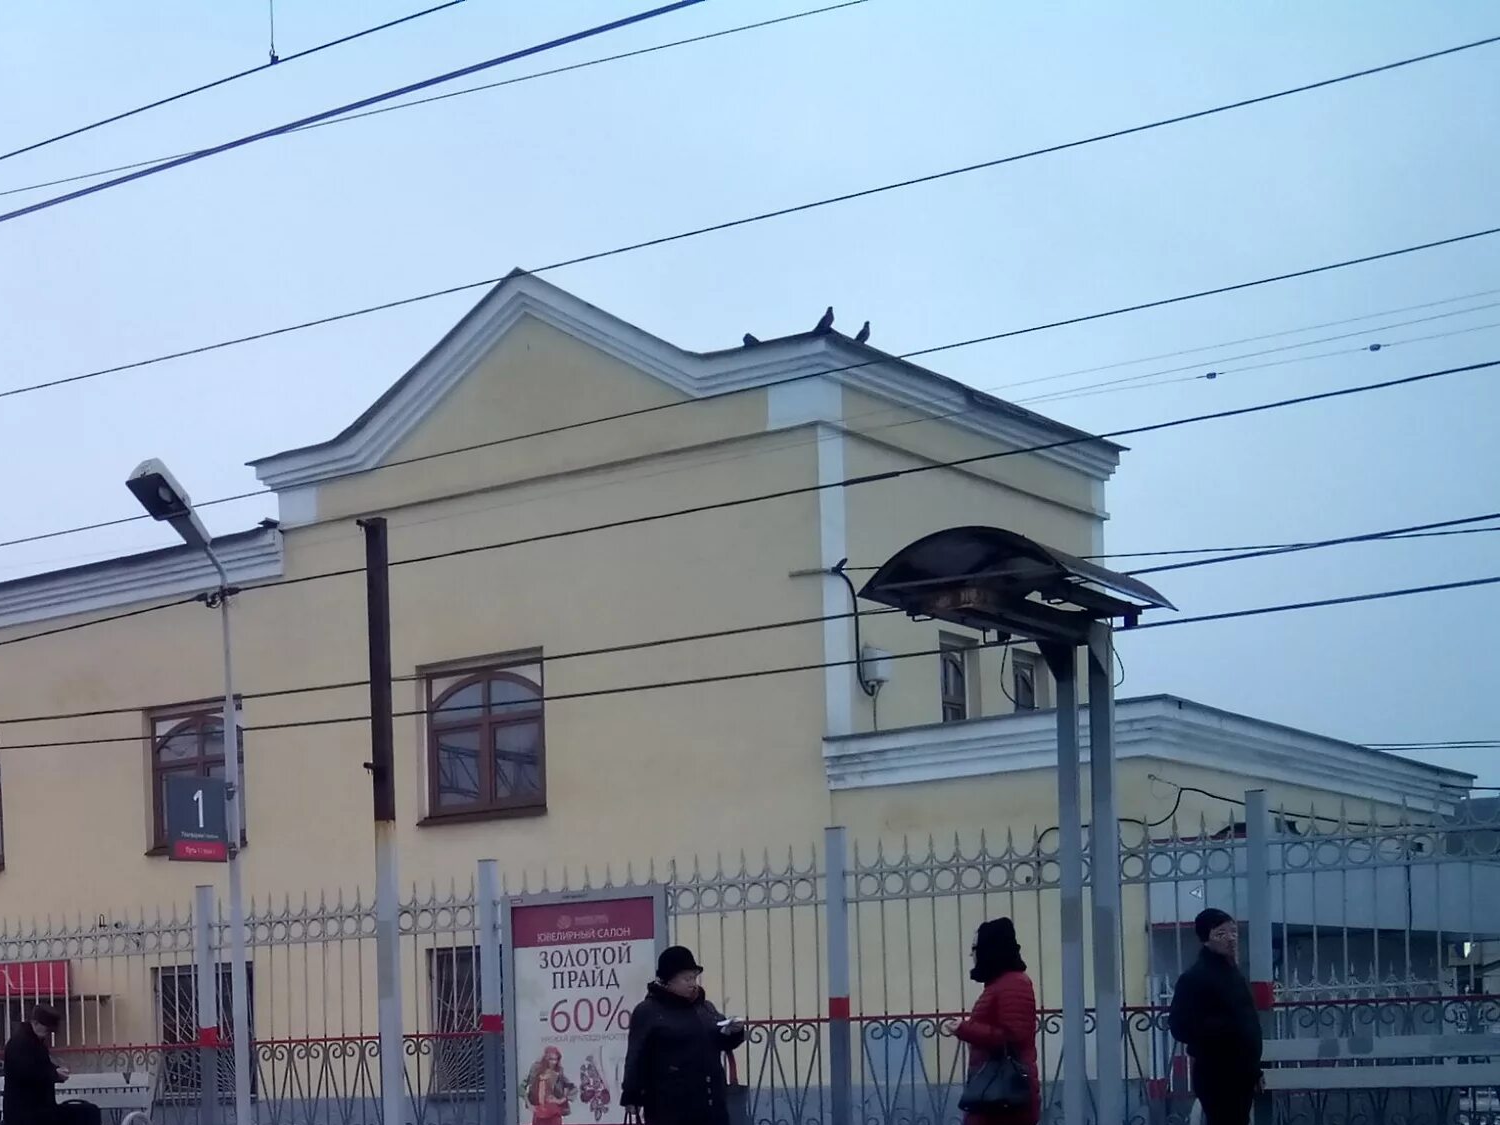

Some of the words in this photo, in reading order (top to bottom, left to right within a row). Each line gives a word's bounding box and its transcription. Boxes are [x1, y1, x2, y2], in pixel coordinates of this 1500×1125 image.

[193, 789, 204, 828] 1
[537, 929, 596, 943] ЮВЕЛИРНЫЙ
[597, 927, 631, 939] САЛОН
[539, 942, 632, 969] ЗОЛОТОЙ
[552, 966, 620, 990] ПРАЙД
[539, 996, 632, 1033] -60%
